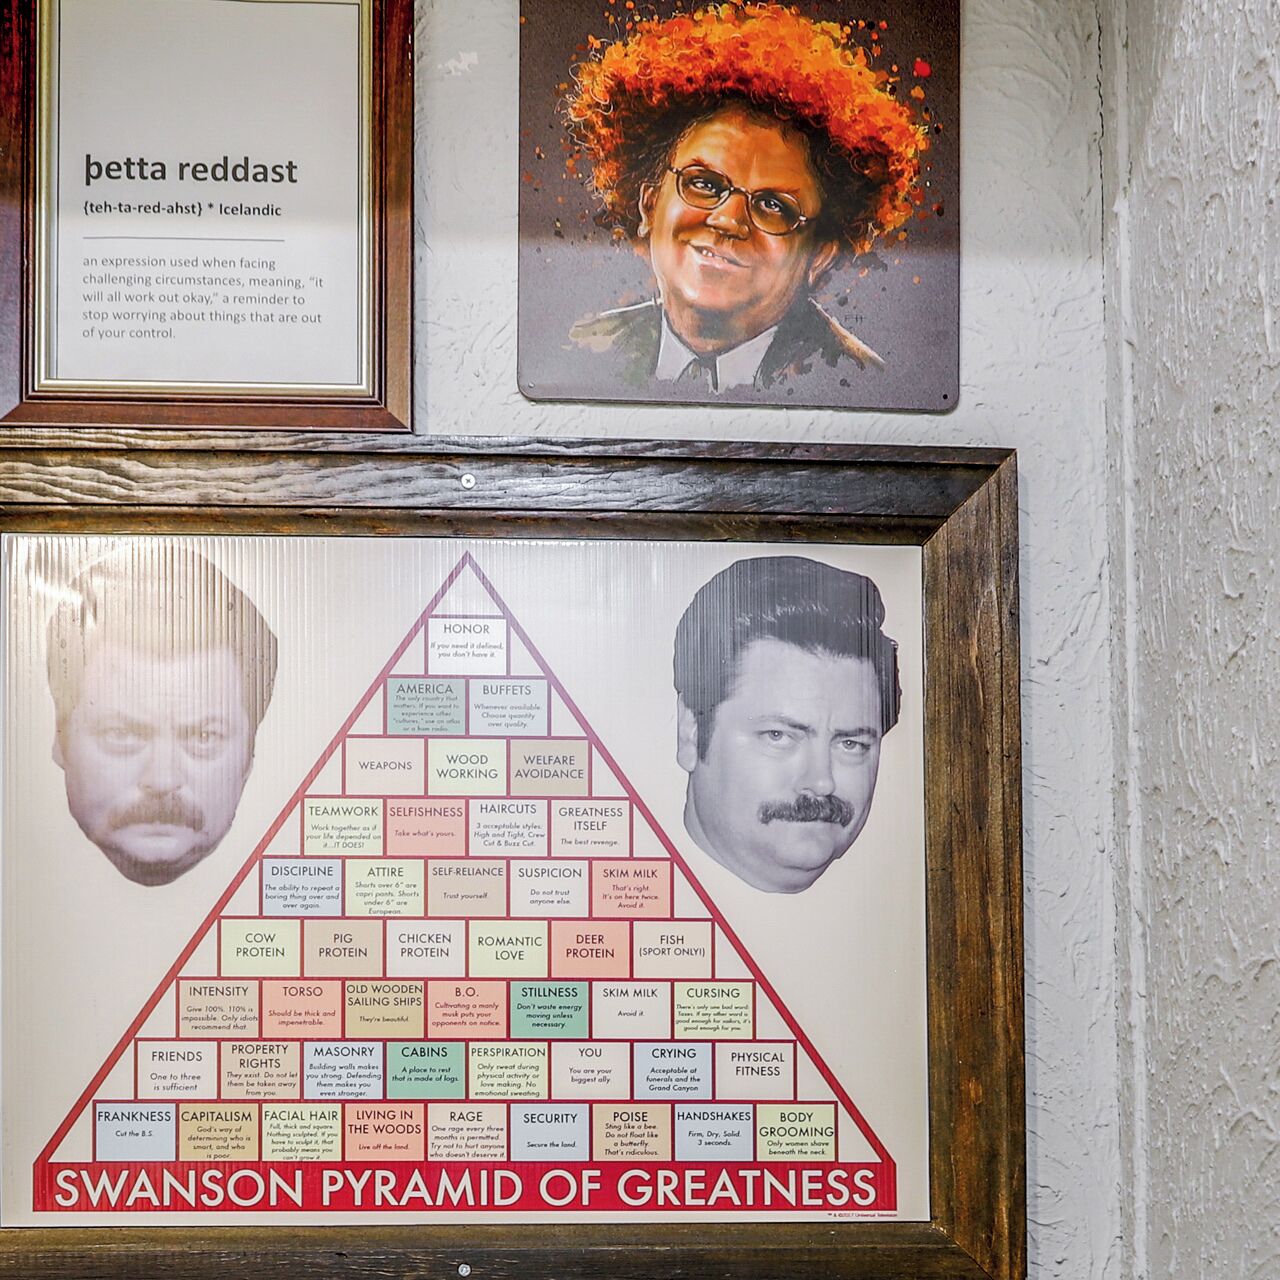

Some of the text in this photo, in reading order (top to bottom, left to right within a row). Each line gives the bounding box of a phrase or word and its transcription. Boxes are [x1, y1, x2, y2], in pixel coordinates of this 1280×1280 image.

[178, 155, 298, 184] reddast
[219, 202, 282, 217] Icelandic
[82, 255, 276, 272] an expression used when facing
[82, 272, 153, 288] challenging
[155, 273, 245, 289] circumstances,
[248, 276, 305, 290] meaning,
[81, 290, 104, 303] will
[106, 290, 121, 303] all
[123, 291, 155, 303] work
[158, 293, 179, 304] out
[222, 295, 230, 304] a
[233, 293, 290, 305] reminder
[292, 295, 306, 306] to
[82, 309, 322, 325] stop worrying about things that are out
[82, 325, 176, 341] of your control.
[443, 623, 491, 635] HONOR
[395, 683, 454, 695] AMERICA
[482, 684, 532, 696] BUFFETS
[445, 753, 489, 765] WOOD
[523, 754, 575, 766] WELFARE
[358, 760, 413, 771] WEAPONS
[435, 768, 499, 780] WORKING
[514, 768, 585, 780] AVOIDANCE
[308, 805, 379, 817] TEAMWORK
[389, 806, 464, 818] SELFISHNESS
[479, 803, 537, 815] HAIRCUTS
[558, 806, 623, 818] GREATNESS
[573, 820, 608, 831] ITSELF
[271, 865, 334, 877] DISCIPLINE
[366, 866, 405, 878] ATTIRE
[431, 866, 504, 877] SELF-RELIANCE
[517, 867, 583, 879] SUSPICION
[602, 868, 658, 879] SKIM MILK
[244, 932, 277, 944] COW
[333, 933, 353, 944] PIG
[397, 933, 452, 944] CHICKEN
[477, 935, 543, 947] ROMANTIC
[575, 933, 605, 945] DEER
[659, 934, 685, 945] FISH
[235, 946, 285, 958] PROTEIN
[318, 947, 368, 958] PROTEIN
[400, 947, 450, 958] PROTEIN
[495, 950, 525, 961] LOVE
[565, 947, 615, 959] PROTEIN
[638, 947, 672, 958] (SPORT
[189, 985, 249, 997] INTENSITY
[282, 986, 324, 997] TORSO
[344, 983, 425, 995] OLD WOODEN
[455, 986, 480, 998] B.O.
[521, 986, 579, 998] STILLNESS
[602, 987, 658, 998] SKIM MILK
[686, 987, 741, 999] CURSING
[347, 996, 423, 1007] SAILING SHIPS
[231, 1043, 289, 1055] PROPERTY
[313, 1046, 375, 1057] MASONRY
[401, 1046, 448, 1058] CABINS
[471, 1047, 546, 1058] PERSPIRATION
[578, 1047, 603, 1058] YOU
[651, 1047, 697, 1059] CRYING
[151, 1050, 203, 1062] FRIENDS
[730, 1051, 785, 1063] PHYSICAL
[239, 1057, 281, 1069] RIGHTS
[149, 1071, 202, 1081] One to three
[649, 1066, 689, 1075] Acceptable
[735, 1065, 781, 1077] FITNESS
[645, 1074, 701, 1083] funerals and the
[153, 1082, 198, 1091] is sufficient
[648, 1083, 699, 1093] Grand Canyon
[97, 1111, 172, 1122] FRANKNESS
[180, 1110, 253, 1122] CAPITALISM
[263, 1110, 339, 1122] FACIAL HAIR
[356, 1109, 414, 1121] LIVING IN
[449, 1111, 483, 1122] RAGE
[523, 1113, 578, 1124] SECURITY
[613, 1111, 649, 1123] POISE
[677, 1111, 751, 1122] HANDSHAKES
[779, 1111, 814, 1123] BODY
[347, 1123, 422, 1135] THE WOODS
[758, 1126, 835, 1138] GROOMING
[54, 1167, 876, 1208] SWANSON PYRAMID OF GREATNESS
